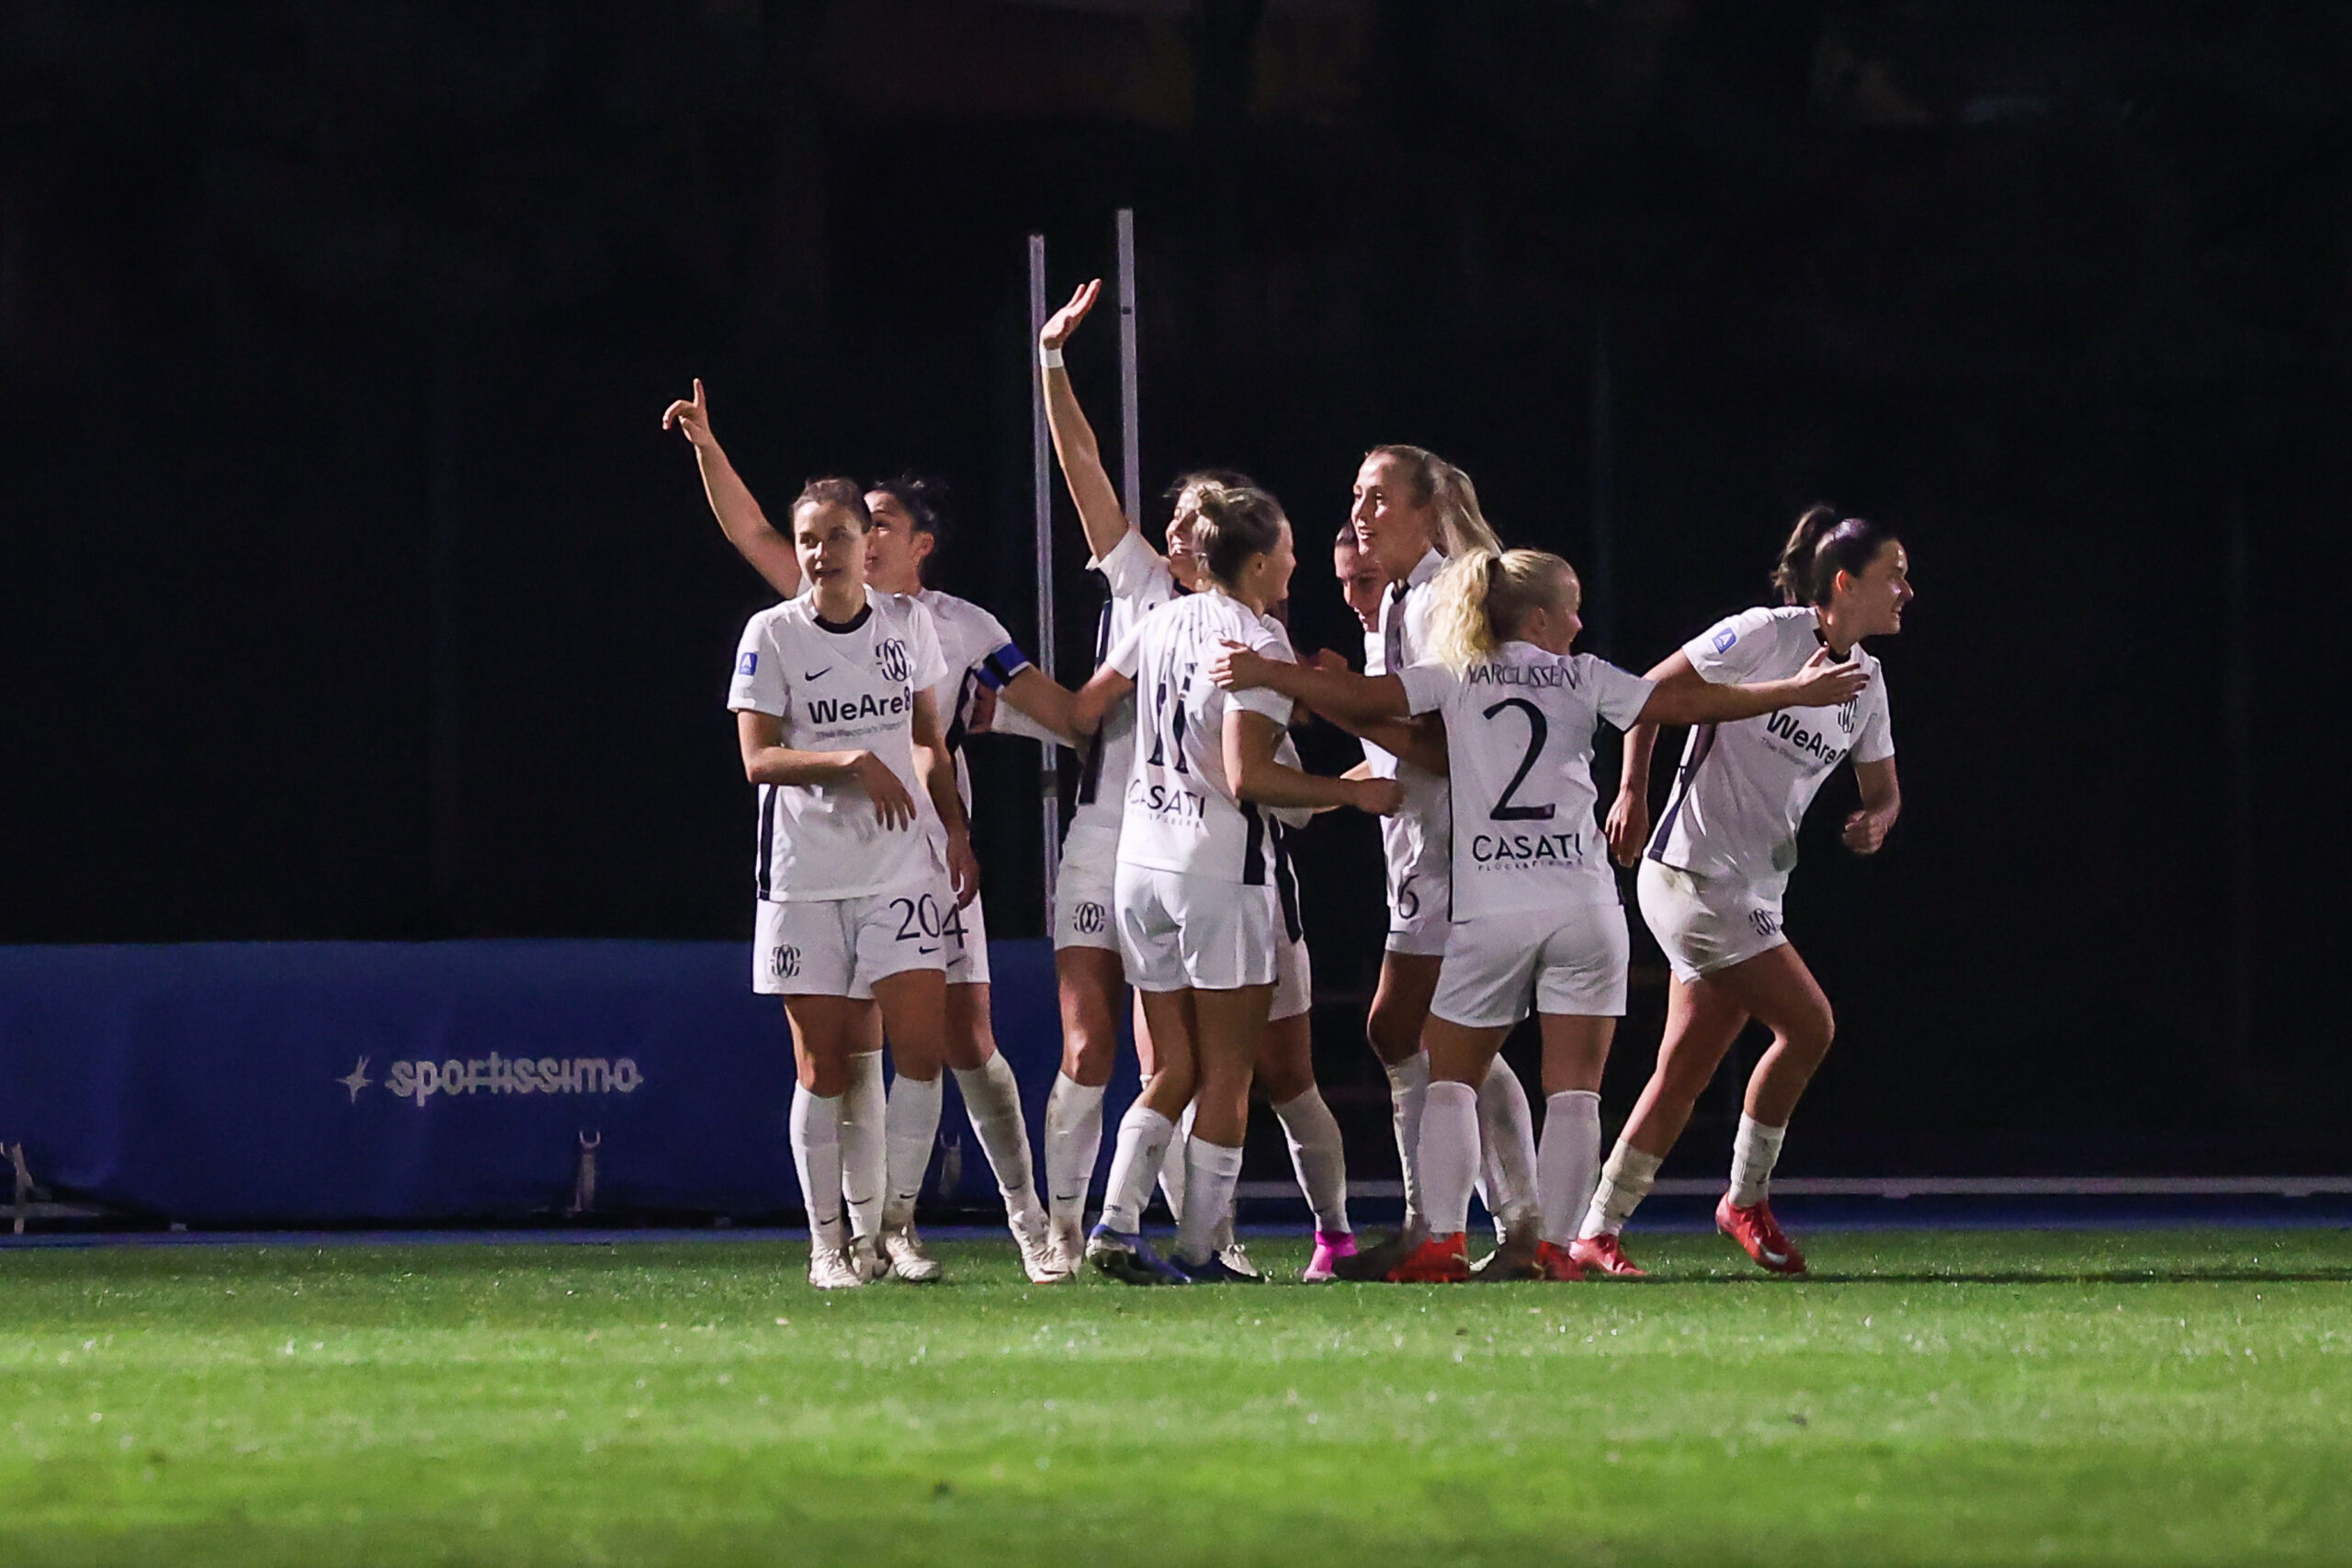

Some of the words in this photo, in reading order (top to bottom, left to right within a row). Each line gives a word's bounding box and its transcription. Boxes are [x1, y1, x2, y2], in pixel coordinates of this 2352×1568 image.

[808, 685, 910, 724] WeAre8
[1482, 697, 1555, 820] 2
[1127, 778, 1205, 818] CSATI
[1472, 833, 1583, 862] CASATI
[889, 894, 941, 942] 20
[1397, 874, 1419, 919] 6
[942, 902, 969, 949] 4
[384, 1051, 645, 1107] sportissimo
